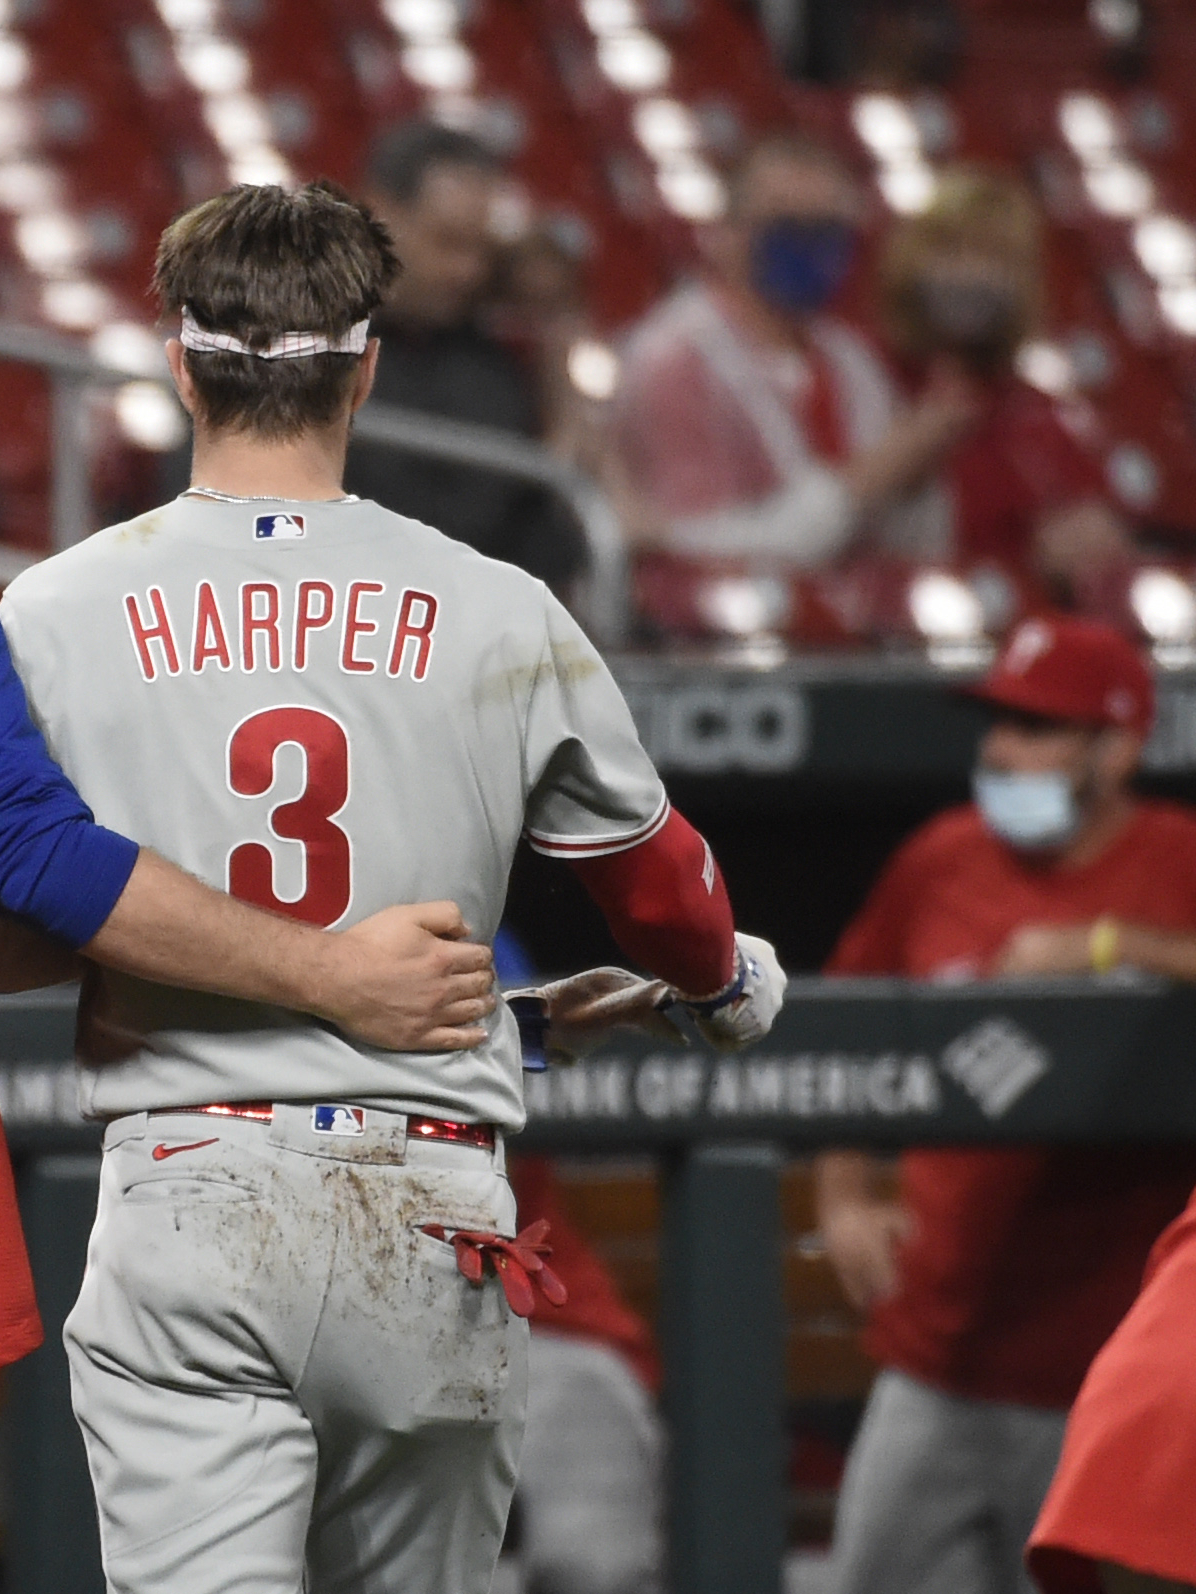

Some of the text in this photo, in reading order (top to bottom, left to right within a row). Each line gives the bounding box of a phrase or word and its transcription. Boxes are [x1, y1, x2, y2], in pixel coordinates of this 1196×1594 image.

[123, 579, 438, 683] HARPER
[225, 703, 354, 931] 3
[520, 1053, 942, 1119] ANK OF AMERICA
